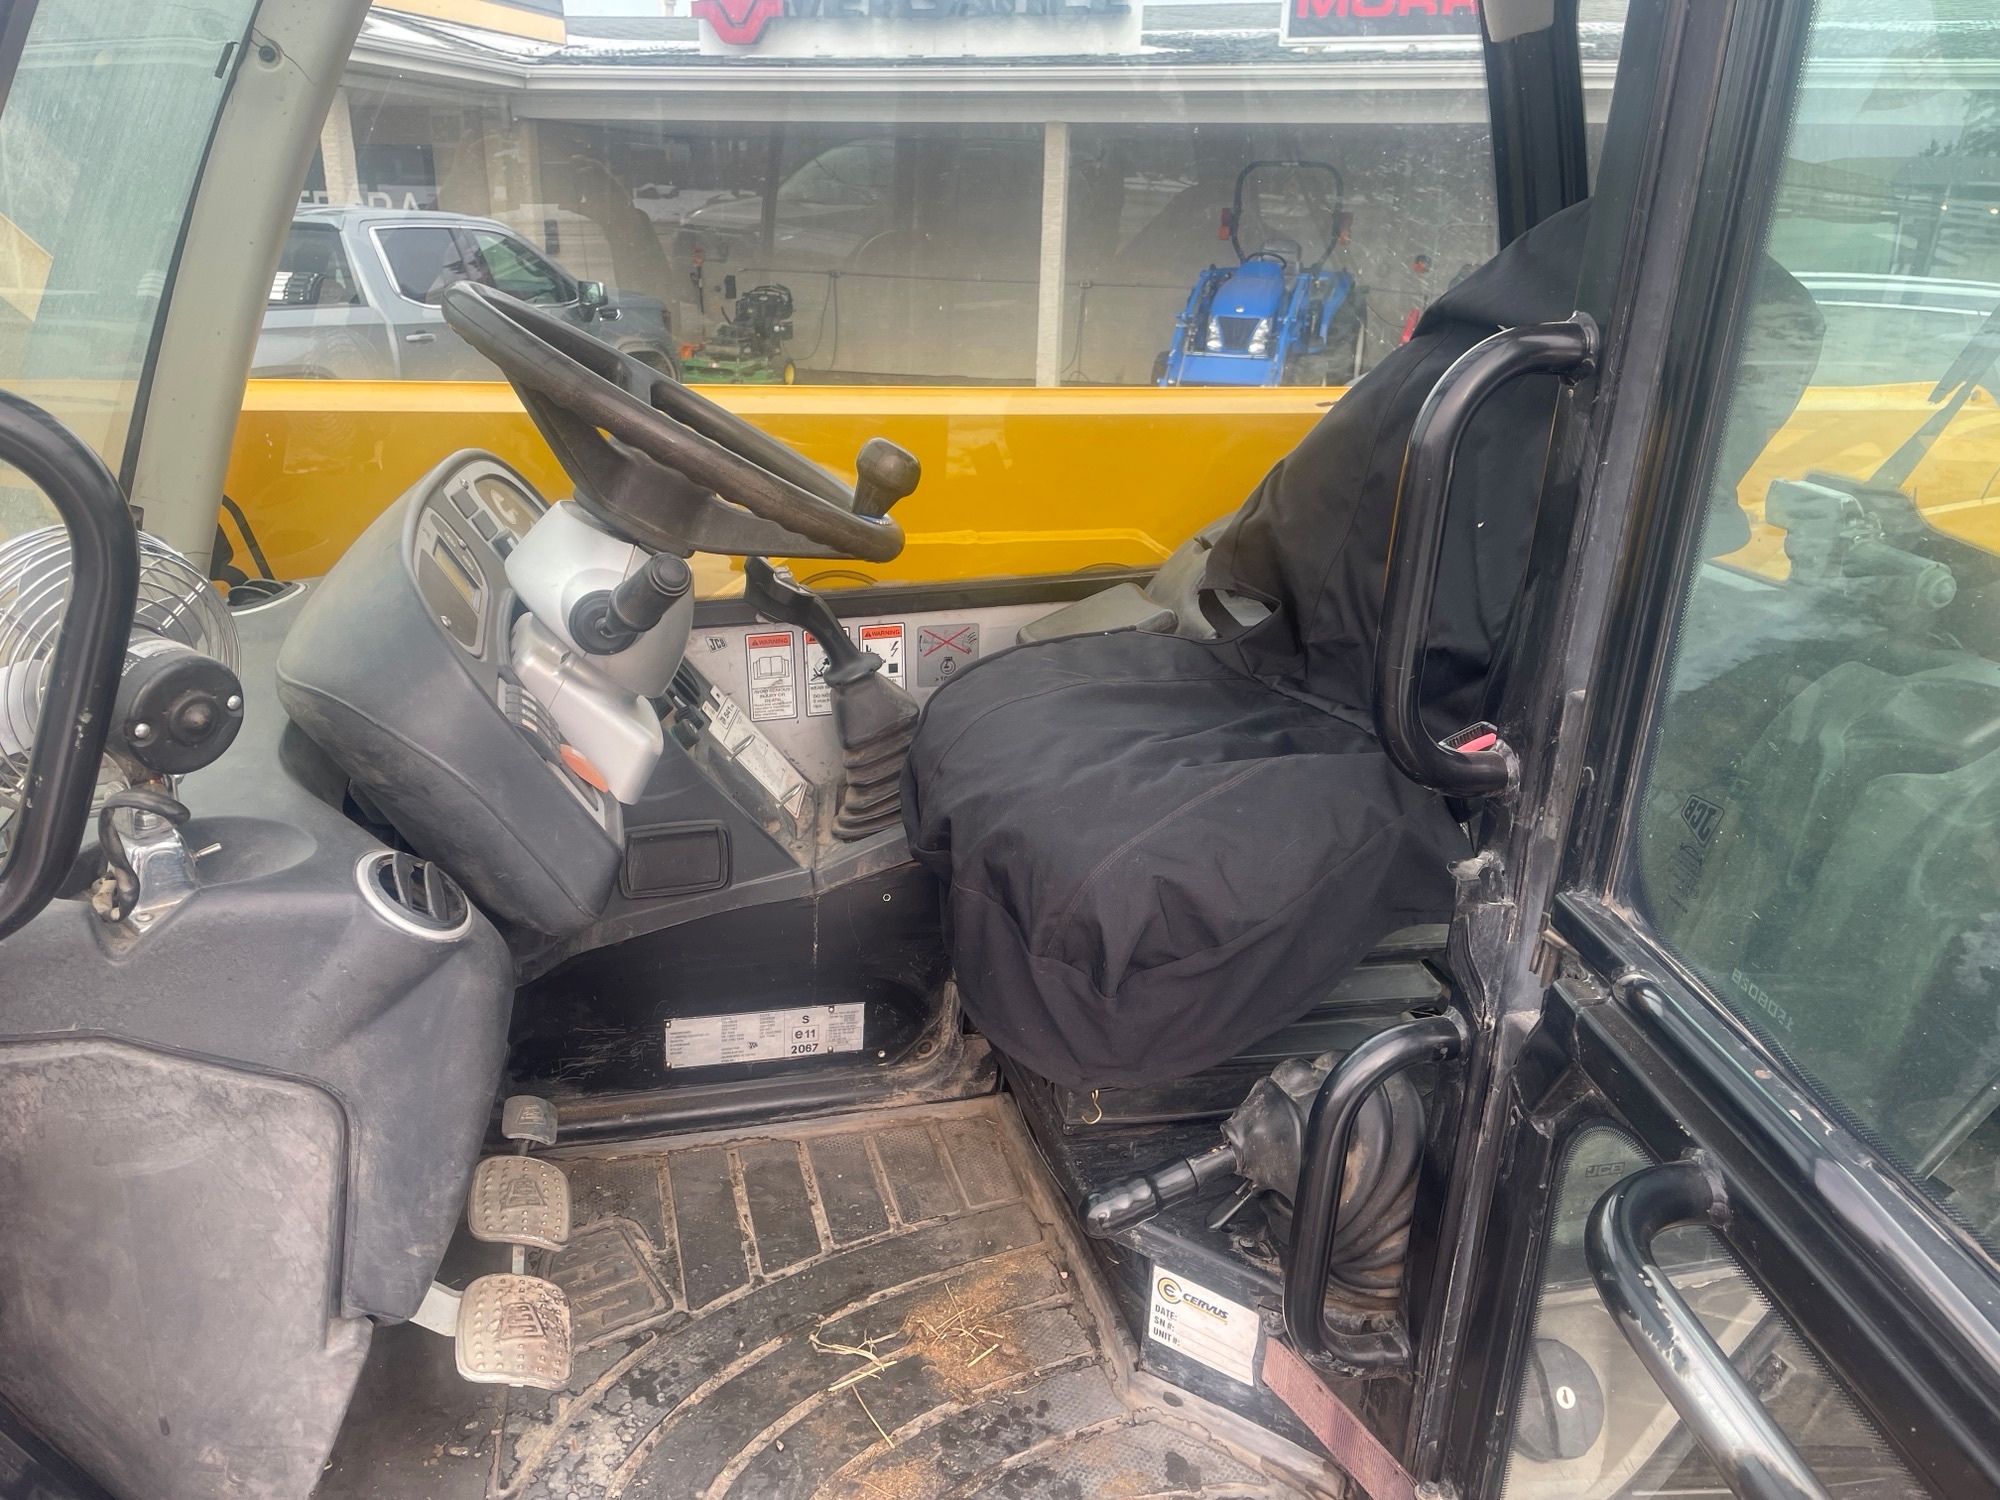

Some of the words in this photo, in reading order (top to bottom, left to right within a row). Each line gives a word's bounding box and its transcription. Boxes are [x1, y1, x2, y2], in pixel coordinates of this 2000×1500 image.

[871, 629, 901, 637] WARNING
[709, 638, 727, 651] JCB
[758, 637, 789, 646] WARNING
[802, 1015, 810, 1024] S
[791, 1043, 819, 1055] 2067
[1586, 1162, 1626, 1178] JCB
[1154, 1304, 1178, 1322] DATE:
[1182, 1293, 1230, 1320] CERVUS
[1154, 1315, 1167, 1328] SN
[1153, 1328, 1172, 1342] UNIT
